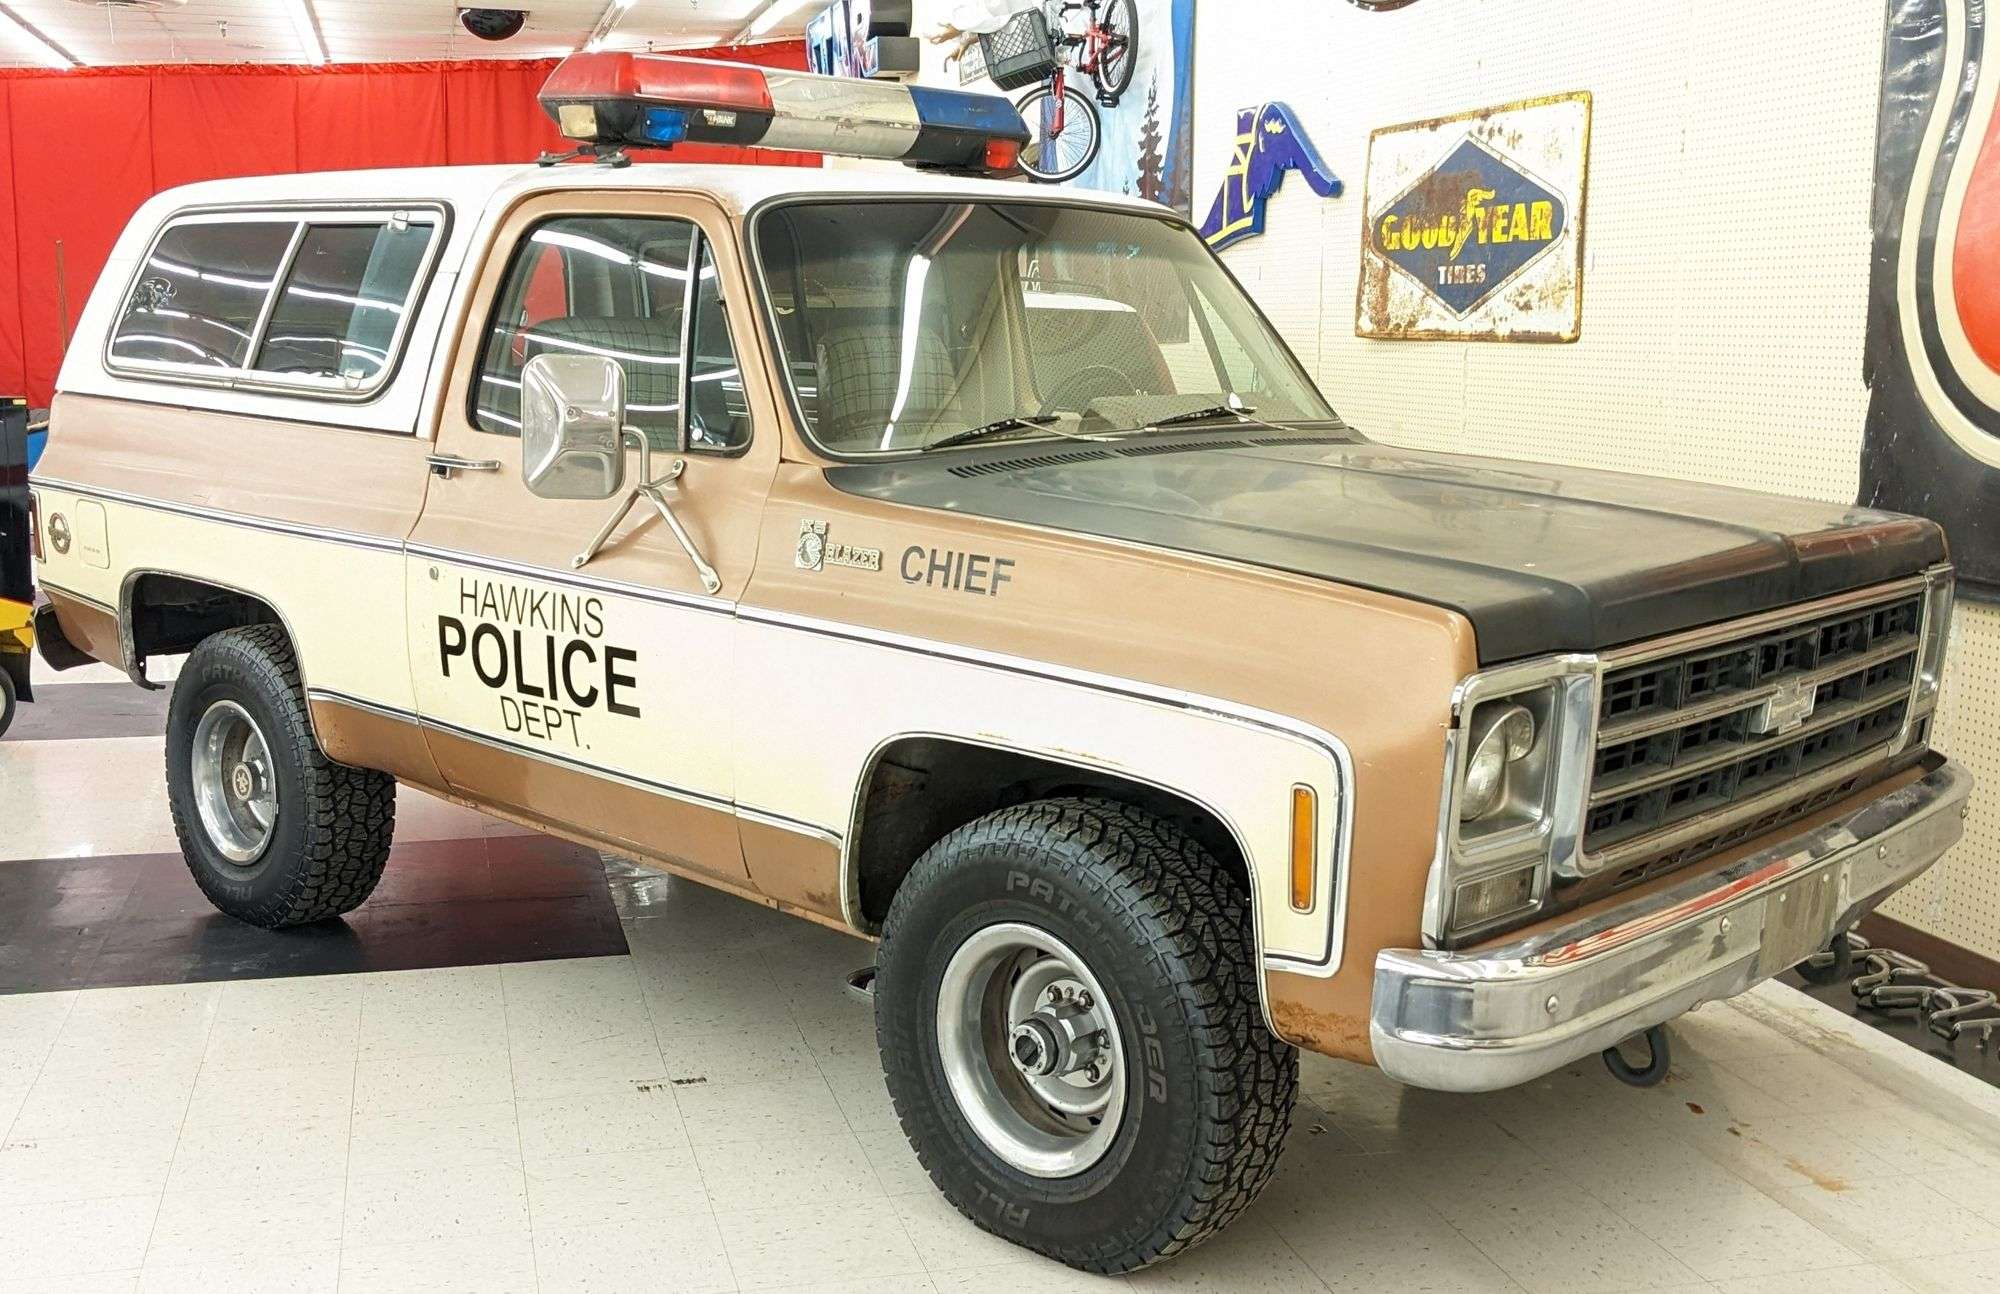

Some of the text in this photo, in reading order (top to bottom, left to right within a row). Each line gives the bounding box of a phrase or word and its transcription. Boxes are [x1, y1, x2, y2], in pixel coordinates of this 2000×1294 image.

[1381, 189, 1553, 259] GOODYEAR
[1438, 264, 1486, 285] TIRES
[823, 542, 880, 571] BLAZER
[900, 545, 1016, 597] CHIEF
[460, 577, 604, 638] HAWKINS
[438, 614, 641, 719] POLICE
[500, 695, 591, 750] DEPT.
[1006, 869, 1168, 1104] PATHDER
